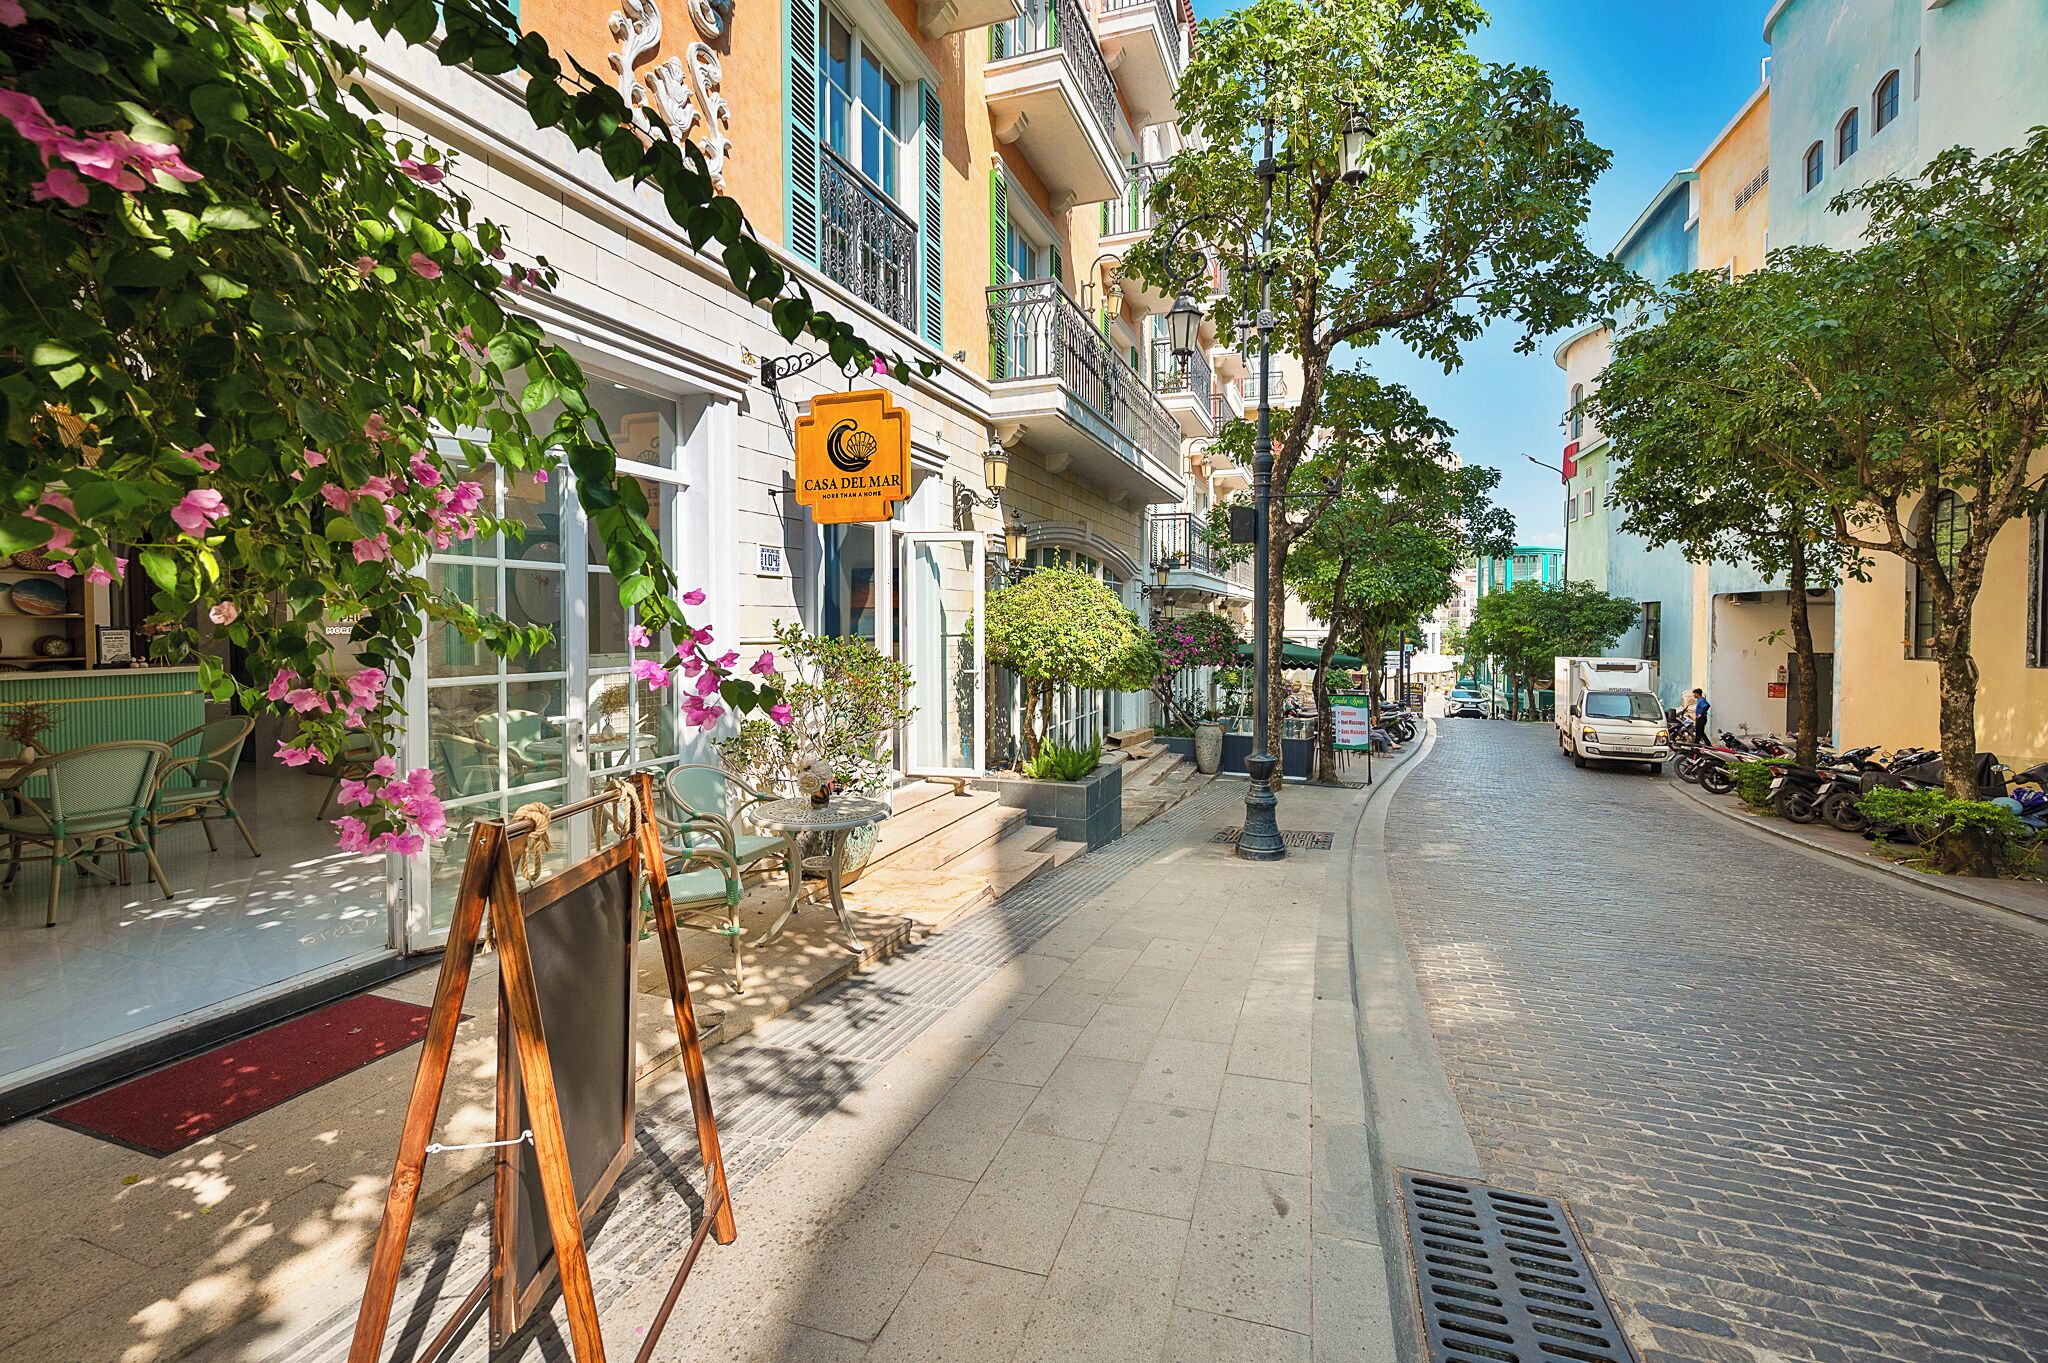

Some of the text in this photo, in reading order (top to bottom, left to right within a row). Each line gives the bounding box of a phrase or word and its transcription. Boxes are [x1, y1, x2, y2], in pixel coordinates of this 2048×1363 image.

[804, 474, 901, 491] CASA DEL MAR
[764, 553, 778, 567] 104
